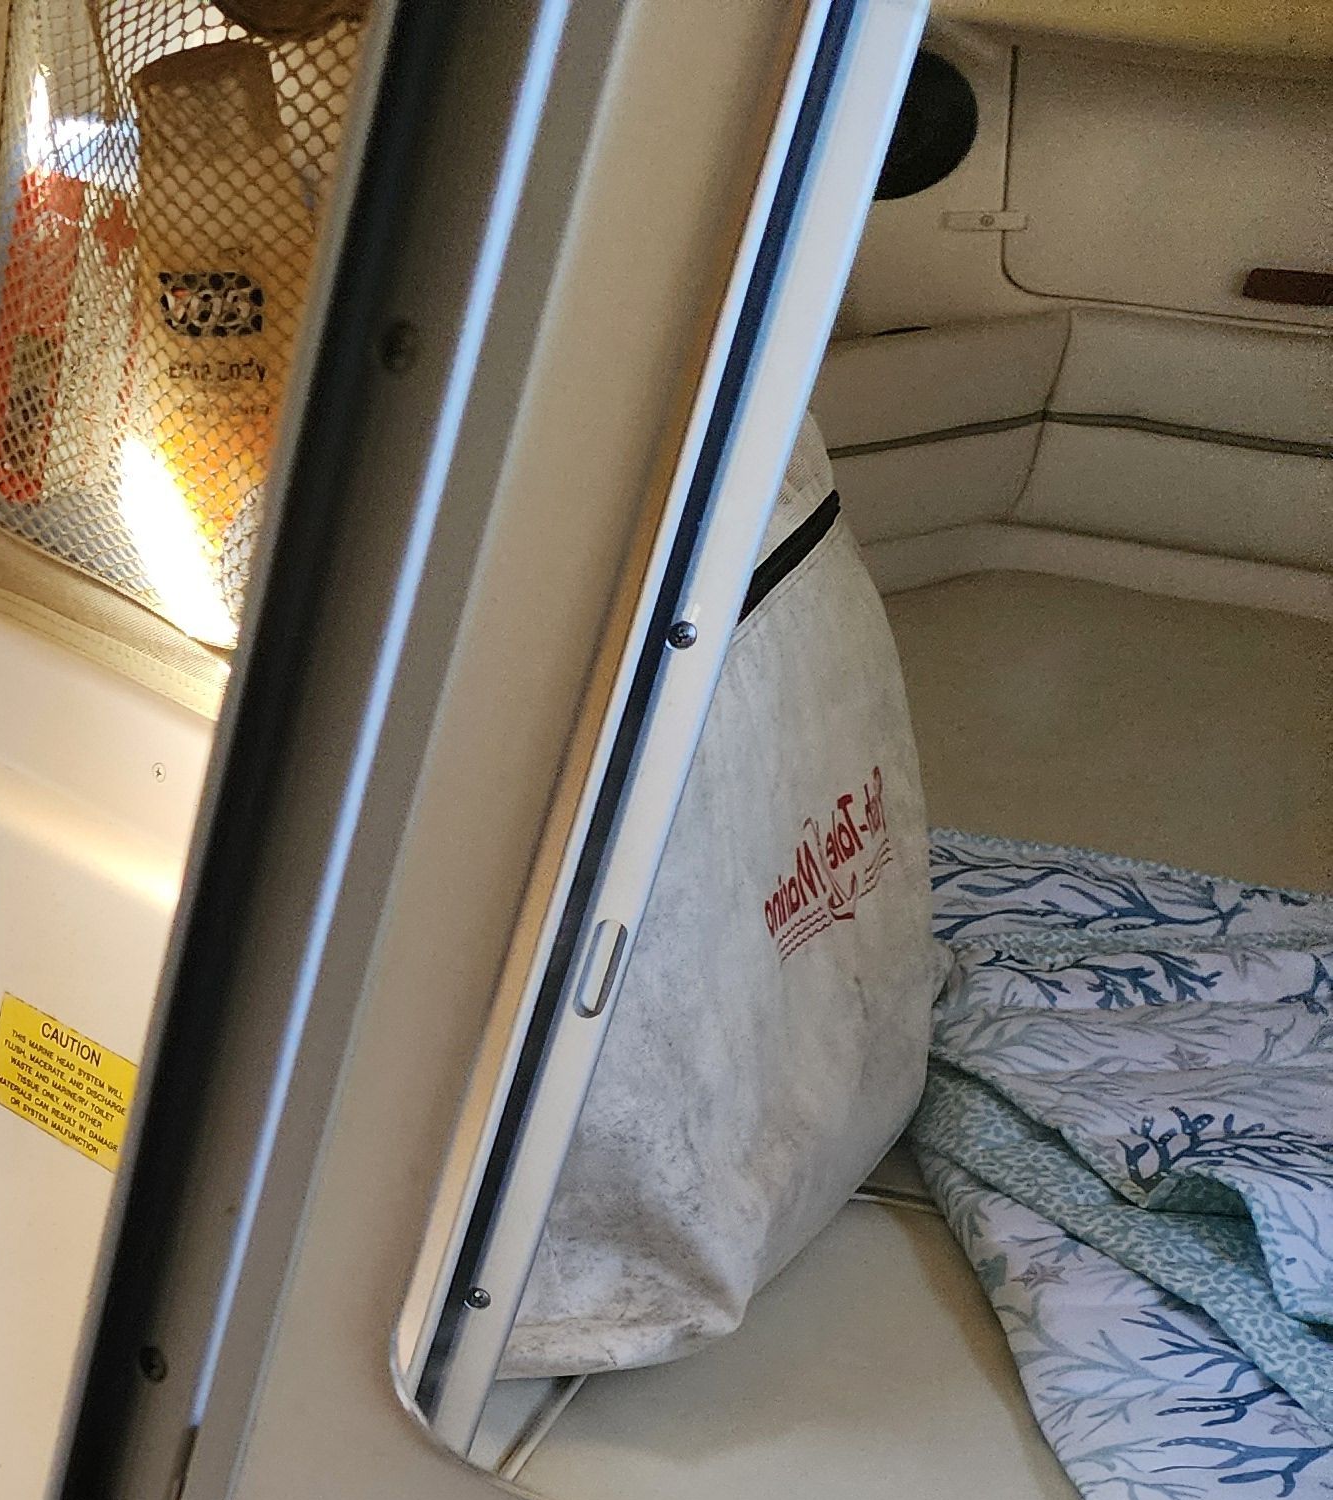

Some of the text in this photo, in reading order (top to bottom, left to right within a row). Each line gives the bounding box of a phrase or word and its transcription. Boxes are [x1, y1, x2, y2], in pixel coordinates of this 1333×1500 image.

[11, 1029, 124, 1100] THIS MARINE HEAD SYSTEM WILL
[40, 1020, 101, 1067] CAUTION
[10, 1055, 32, 1074] WASTE
[34, 1070, 49, 1084] AND
[90, 1102, 114, 1122] TOILET
[16, 1072, 39, 1092] TISSUE
[62, 1100, 76, 1114] ANY
[78, 1109, 102, 1129] OTHER
[34, 1097, 49, 1111] CAN
[50, 1106, 76, 1128] RESULT
[78, 1123, 86, 1134] IN
[68, 1076, 83, 1091] AND
[85, 1086, 126, 1116] DISCHARGE
[10, 1095, 98, 1154] OR SYSTEM MALFUNCTION
